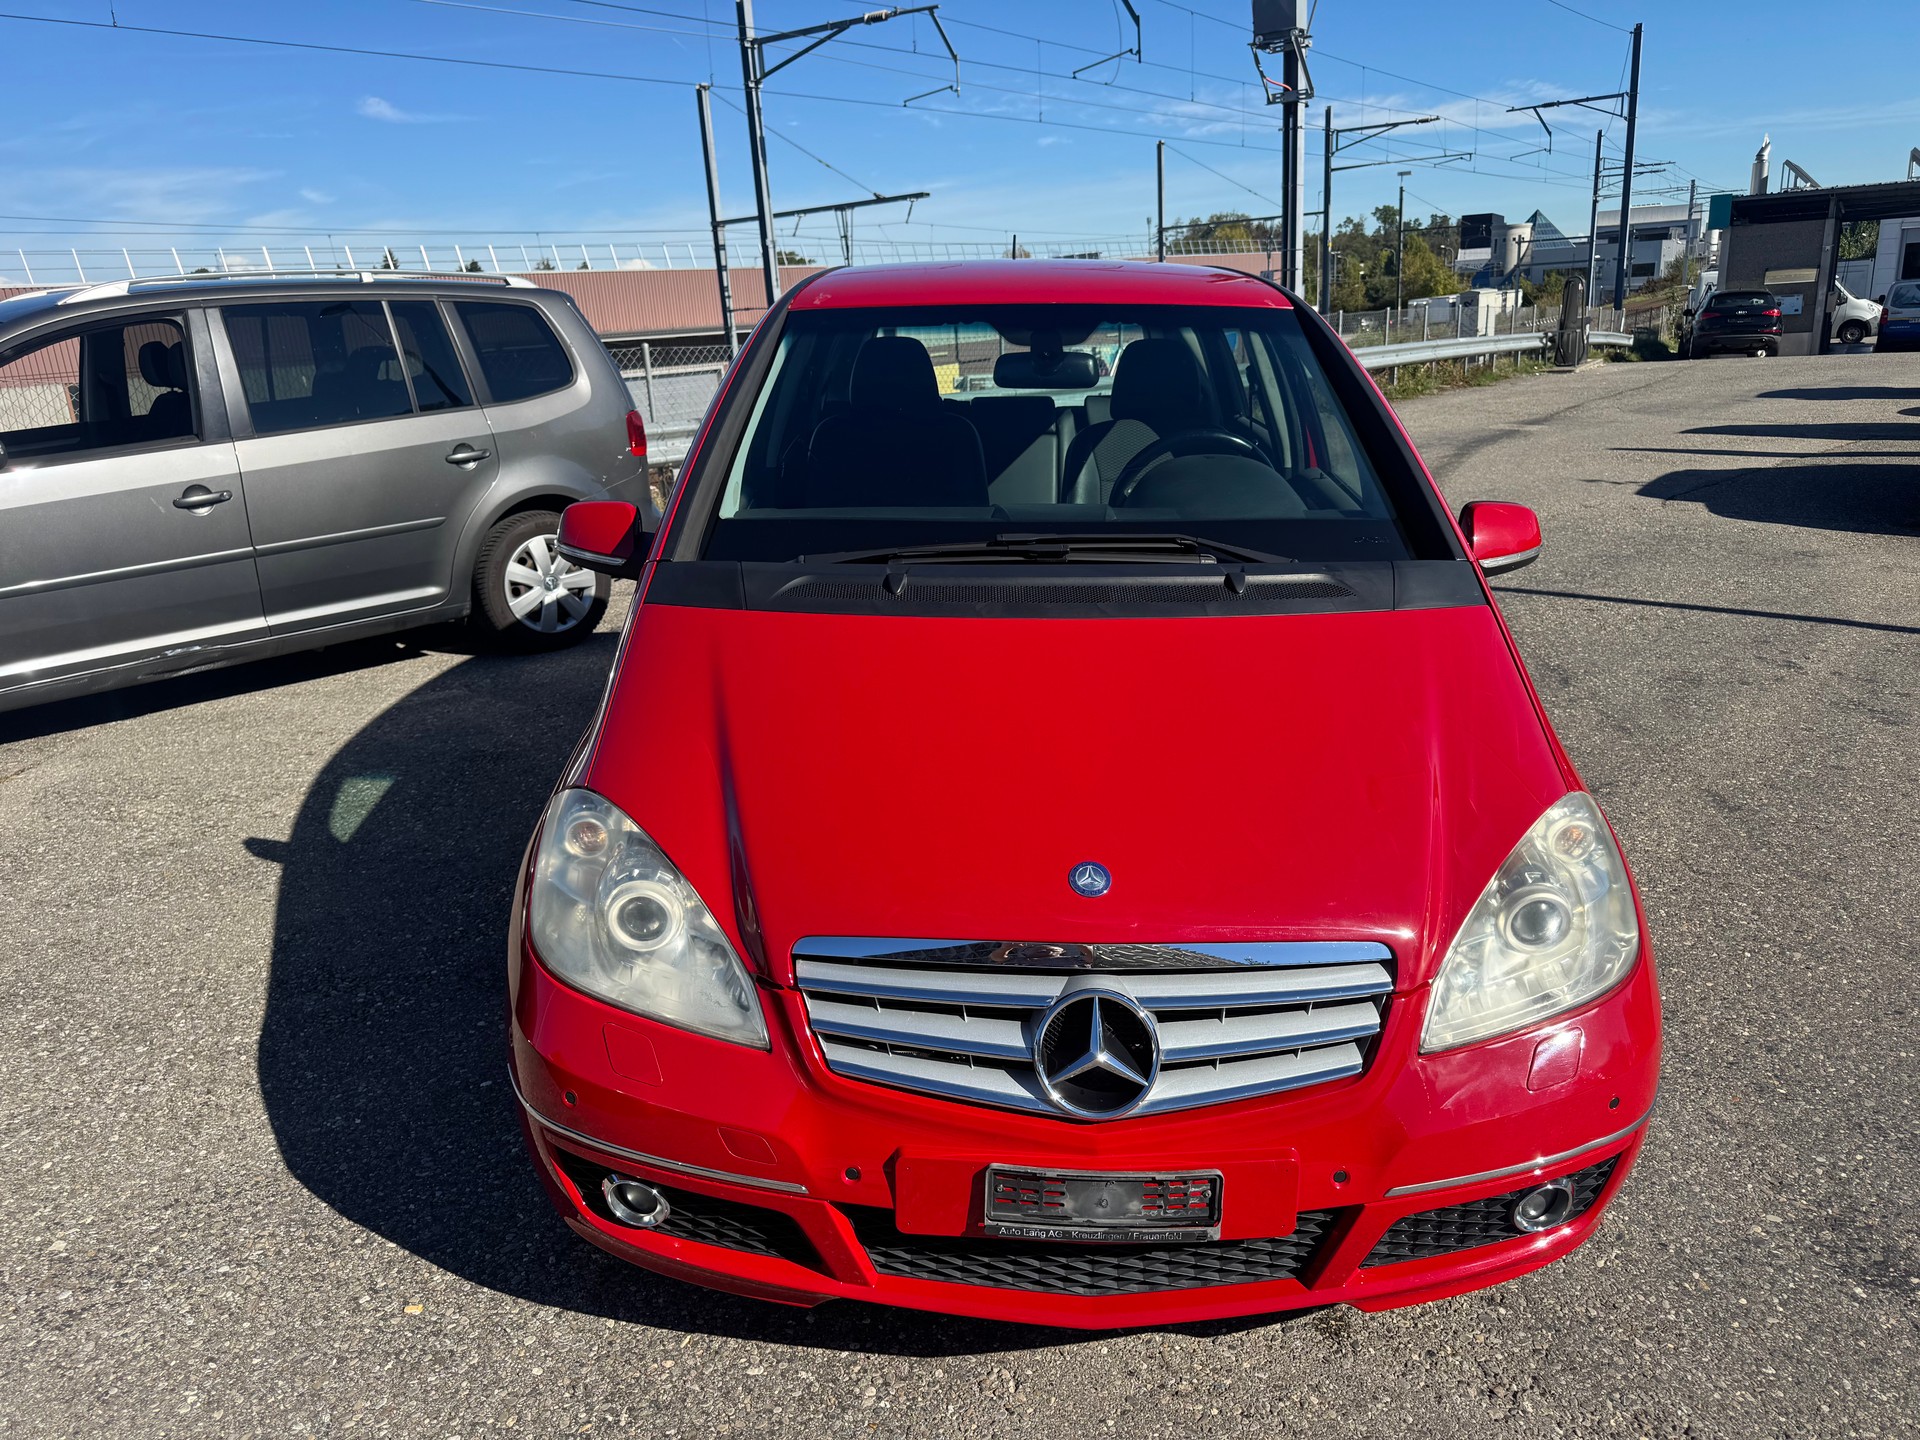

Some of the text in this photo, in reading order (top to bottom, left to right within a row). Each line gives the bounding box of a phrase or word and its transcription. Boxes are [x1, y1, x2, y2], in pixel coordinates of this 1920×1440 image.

[999, 1226, 1021, 1236] Auto
[1023, 1228, 1046, 1239] Lang
[1047, 1229, 1063, 1238] AG
[1071, 1230, 1125, 1242] Kreuzlingen
[1133, 1232, 1182, 1240] Frauenfeld
